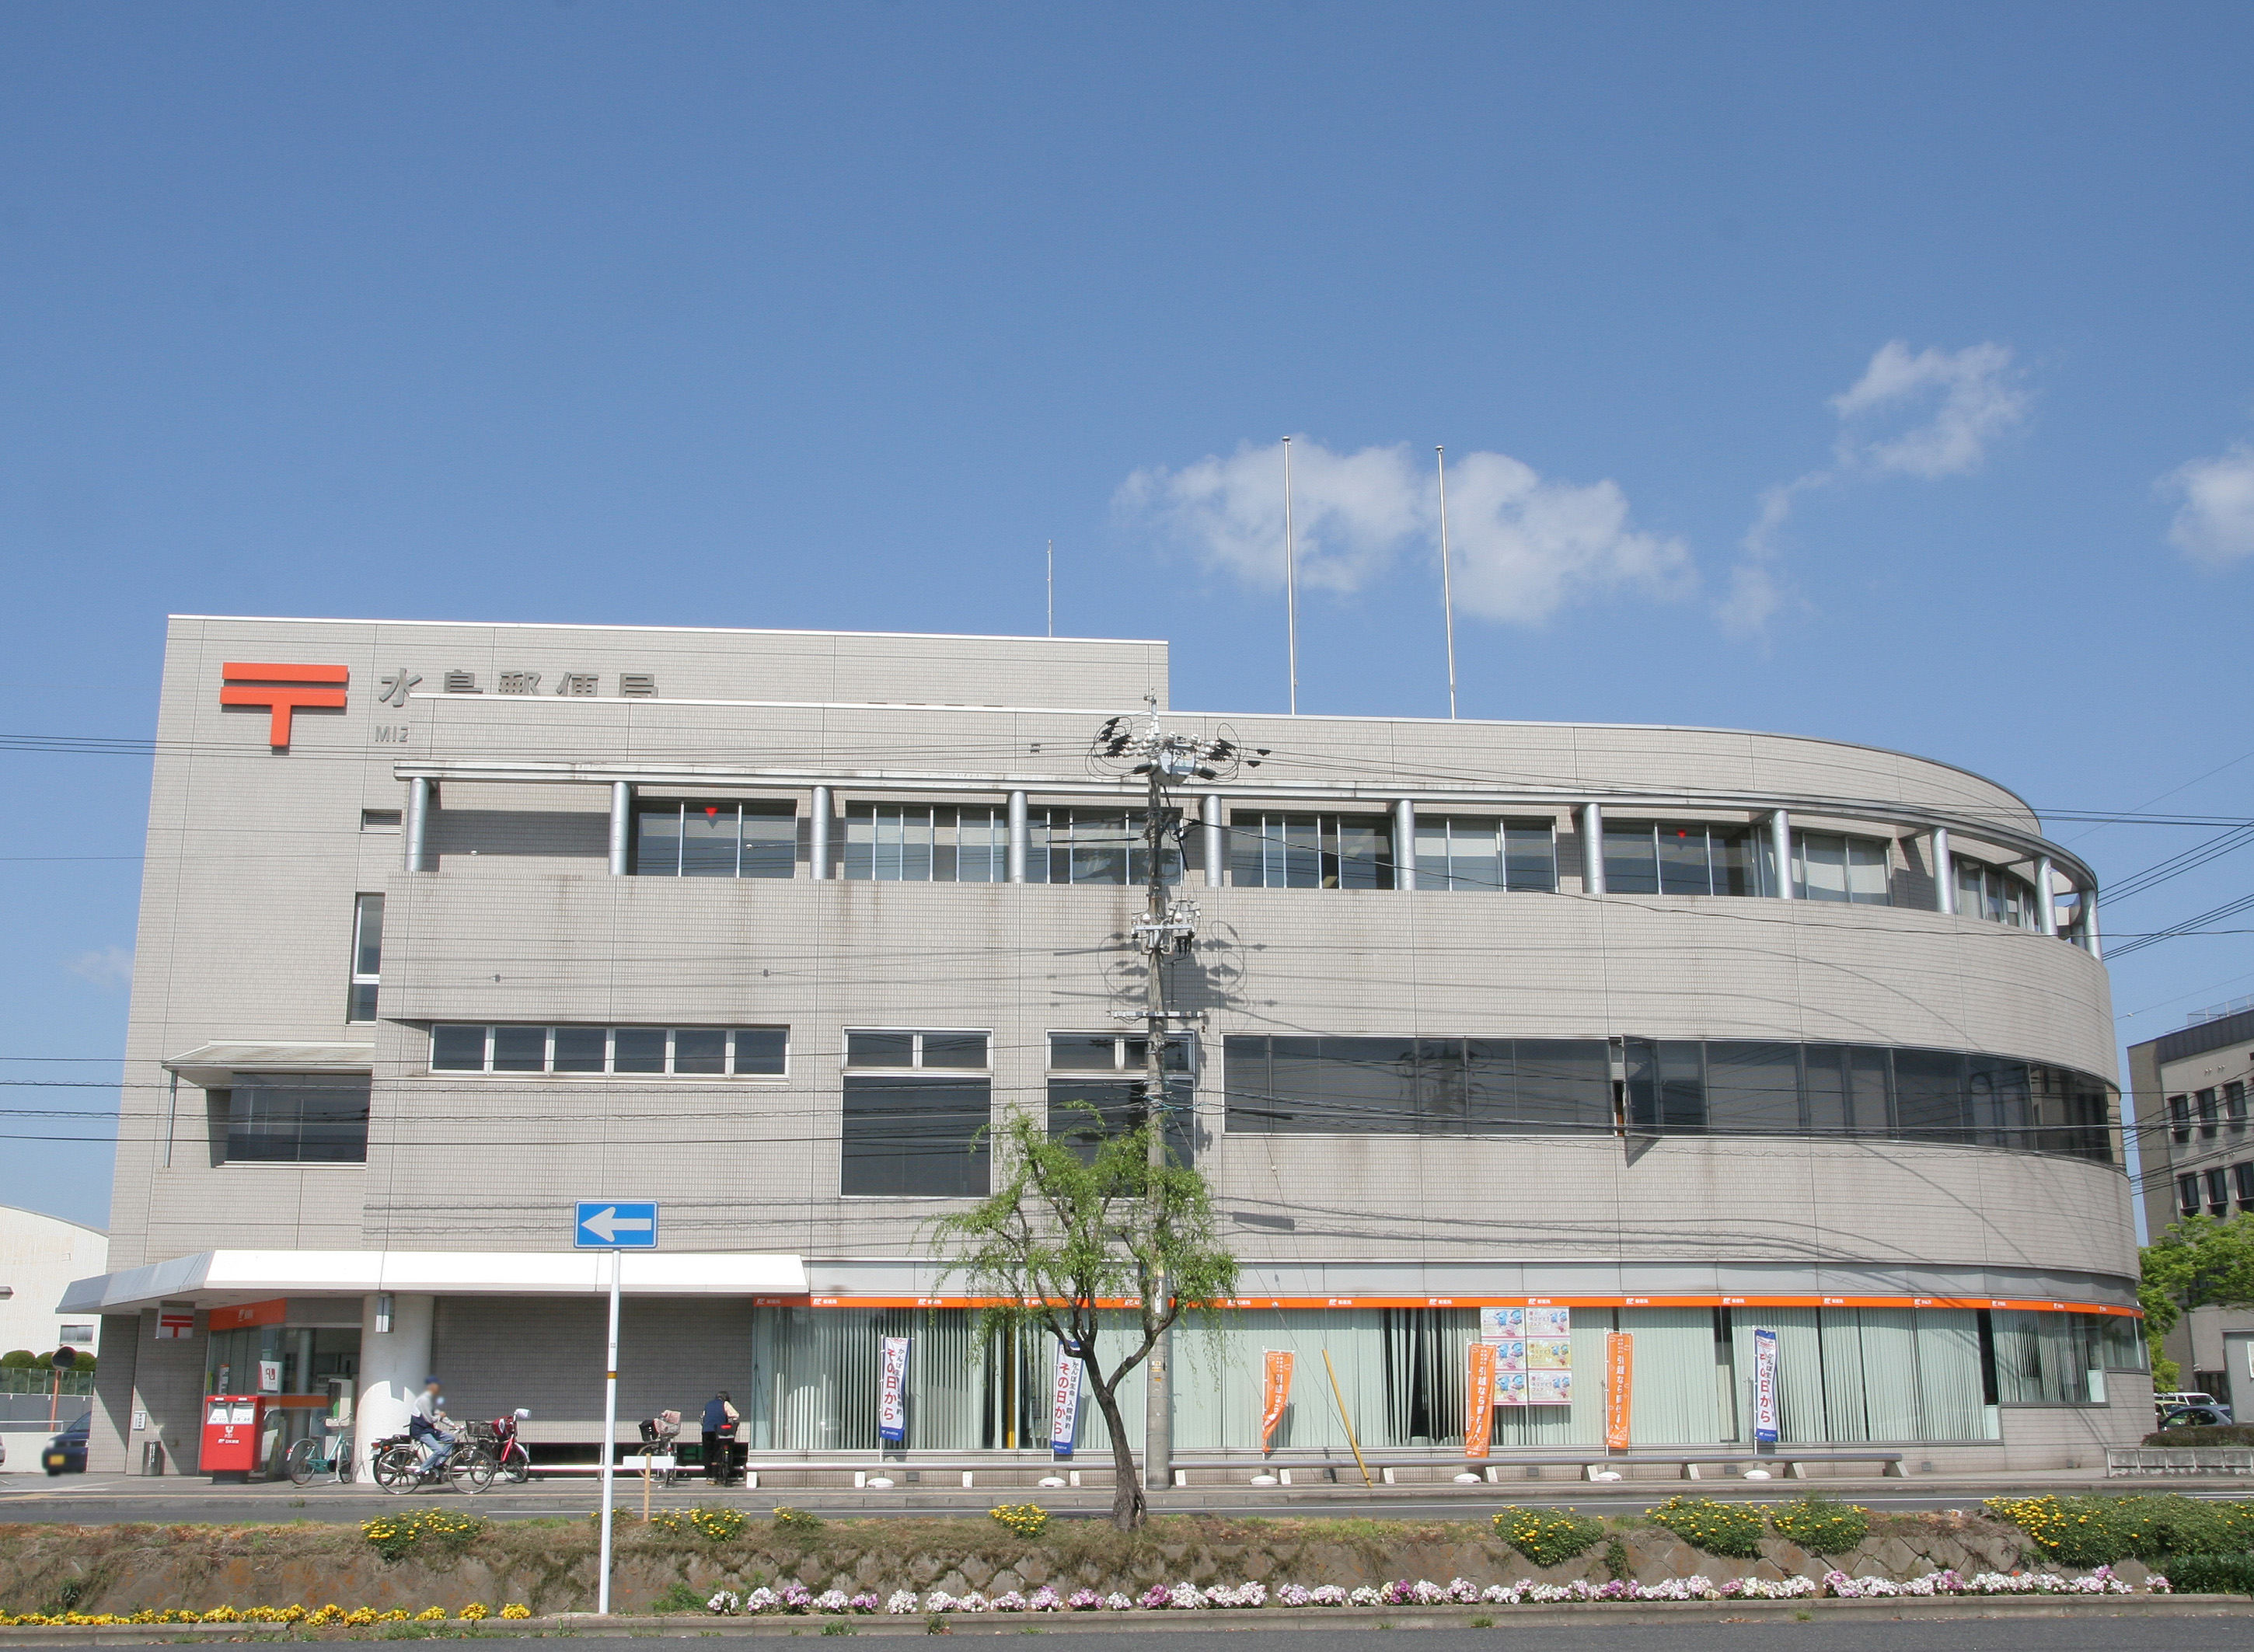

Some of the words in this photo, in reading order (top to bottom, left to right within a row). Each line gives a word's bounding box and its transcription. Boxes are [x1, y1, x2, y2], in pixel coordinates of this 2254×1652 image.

[884, 1348, 897, 1420] その日から
[1054, 1362, 1069, 1434] その日から
